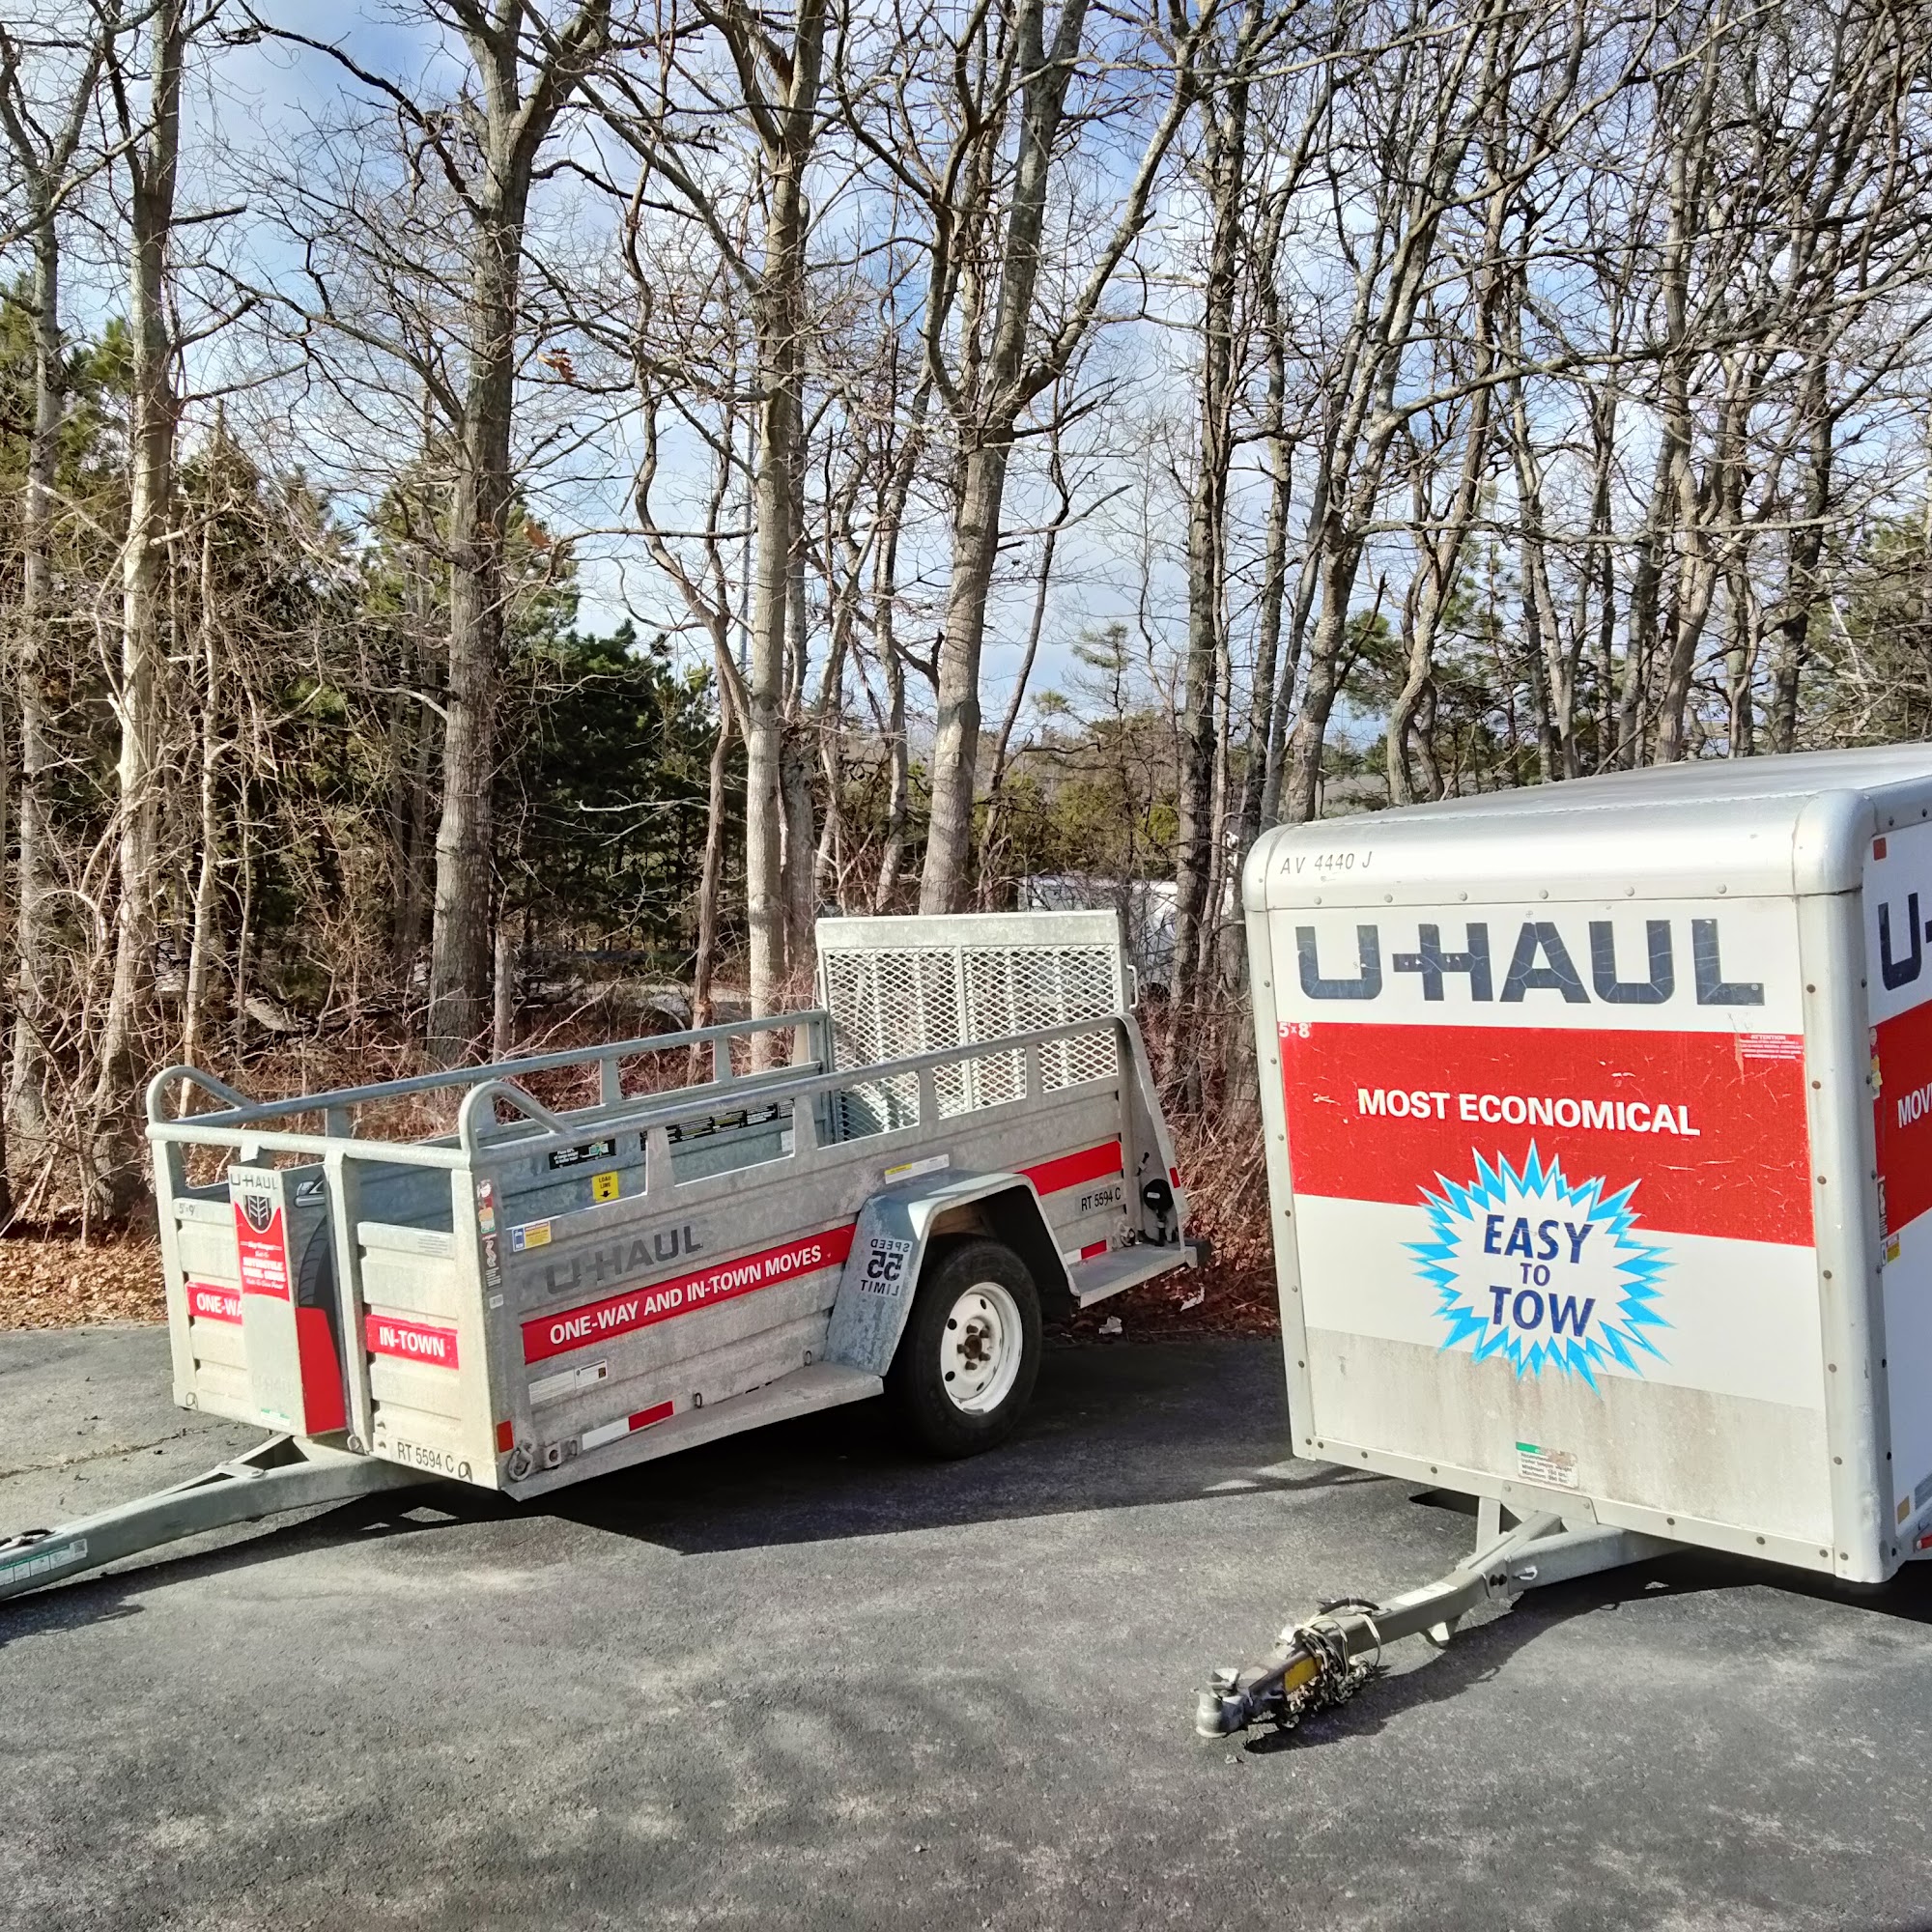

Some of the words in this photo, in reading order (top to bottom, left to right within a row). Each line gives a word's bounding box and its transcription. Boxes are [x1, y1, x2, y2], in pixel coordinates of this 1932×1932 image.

[1280, 857, 1306, 874] AV
[1314, 853, 1354, 870] 4440
[1361, 851, 1373, 868] J
[1295, 919, 1766, 1006] U-HAUL
[1357, 1088, 1450, 1120] MOST
[1459, 1094, 1701, 1136] ECONOMICAL
[1897, 1081, 1932, 1128] MOV
[231, 1174, 277, 1190] U-HAUL
[1081, 1195, 1093, 1211] RT
[1094, 1189, 1113, 1208] 5594
[1115, 1187, 1122, 1201] C
[1484, 1214, 1594, 1264] EASY
[546, 1225, 703, 1294] U-HAUL
[1520, 1263, 1550, 1286] TO
[196, 1292, 242, 1316] ONE-WA
[550, 1301, 639, 1345] ONE-WAY
[644, 1288, 683, 1316] AND
[687, 1263, 761, 1302] IN-TOWN
[765, 1245, 822, 1278] MOVES
[1489, 1286, 1596, 1337] TOW
[379, 1326, 445, 1357] IN-TOWN
[397, 1441, 412, 1462] RT
[415, 1447, 441, 1469] 5594
[445, 1455, 454, 1473] C
